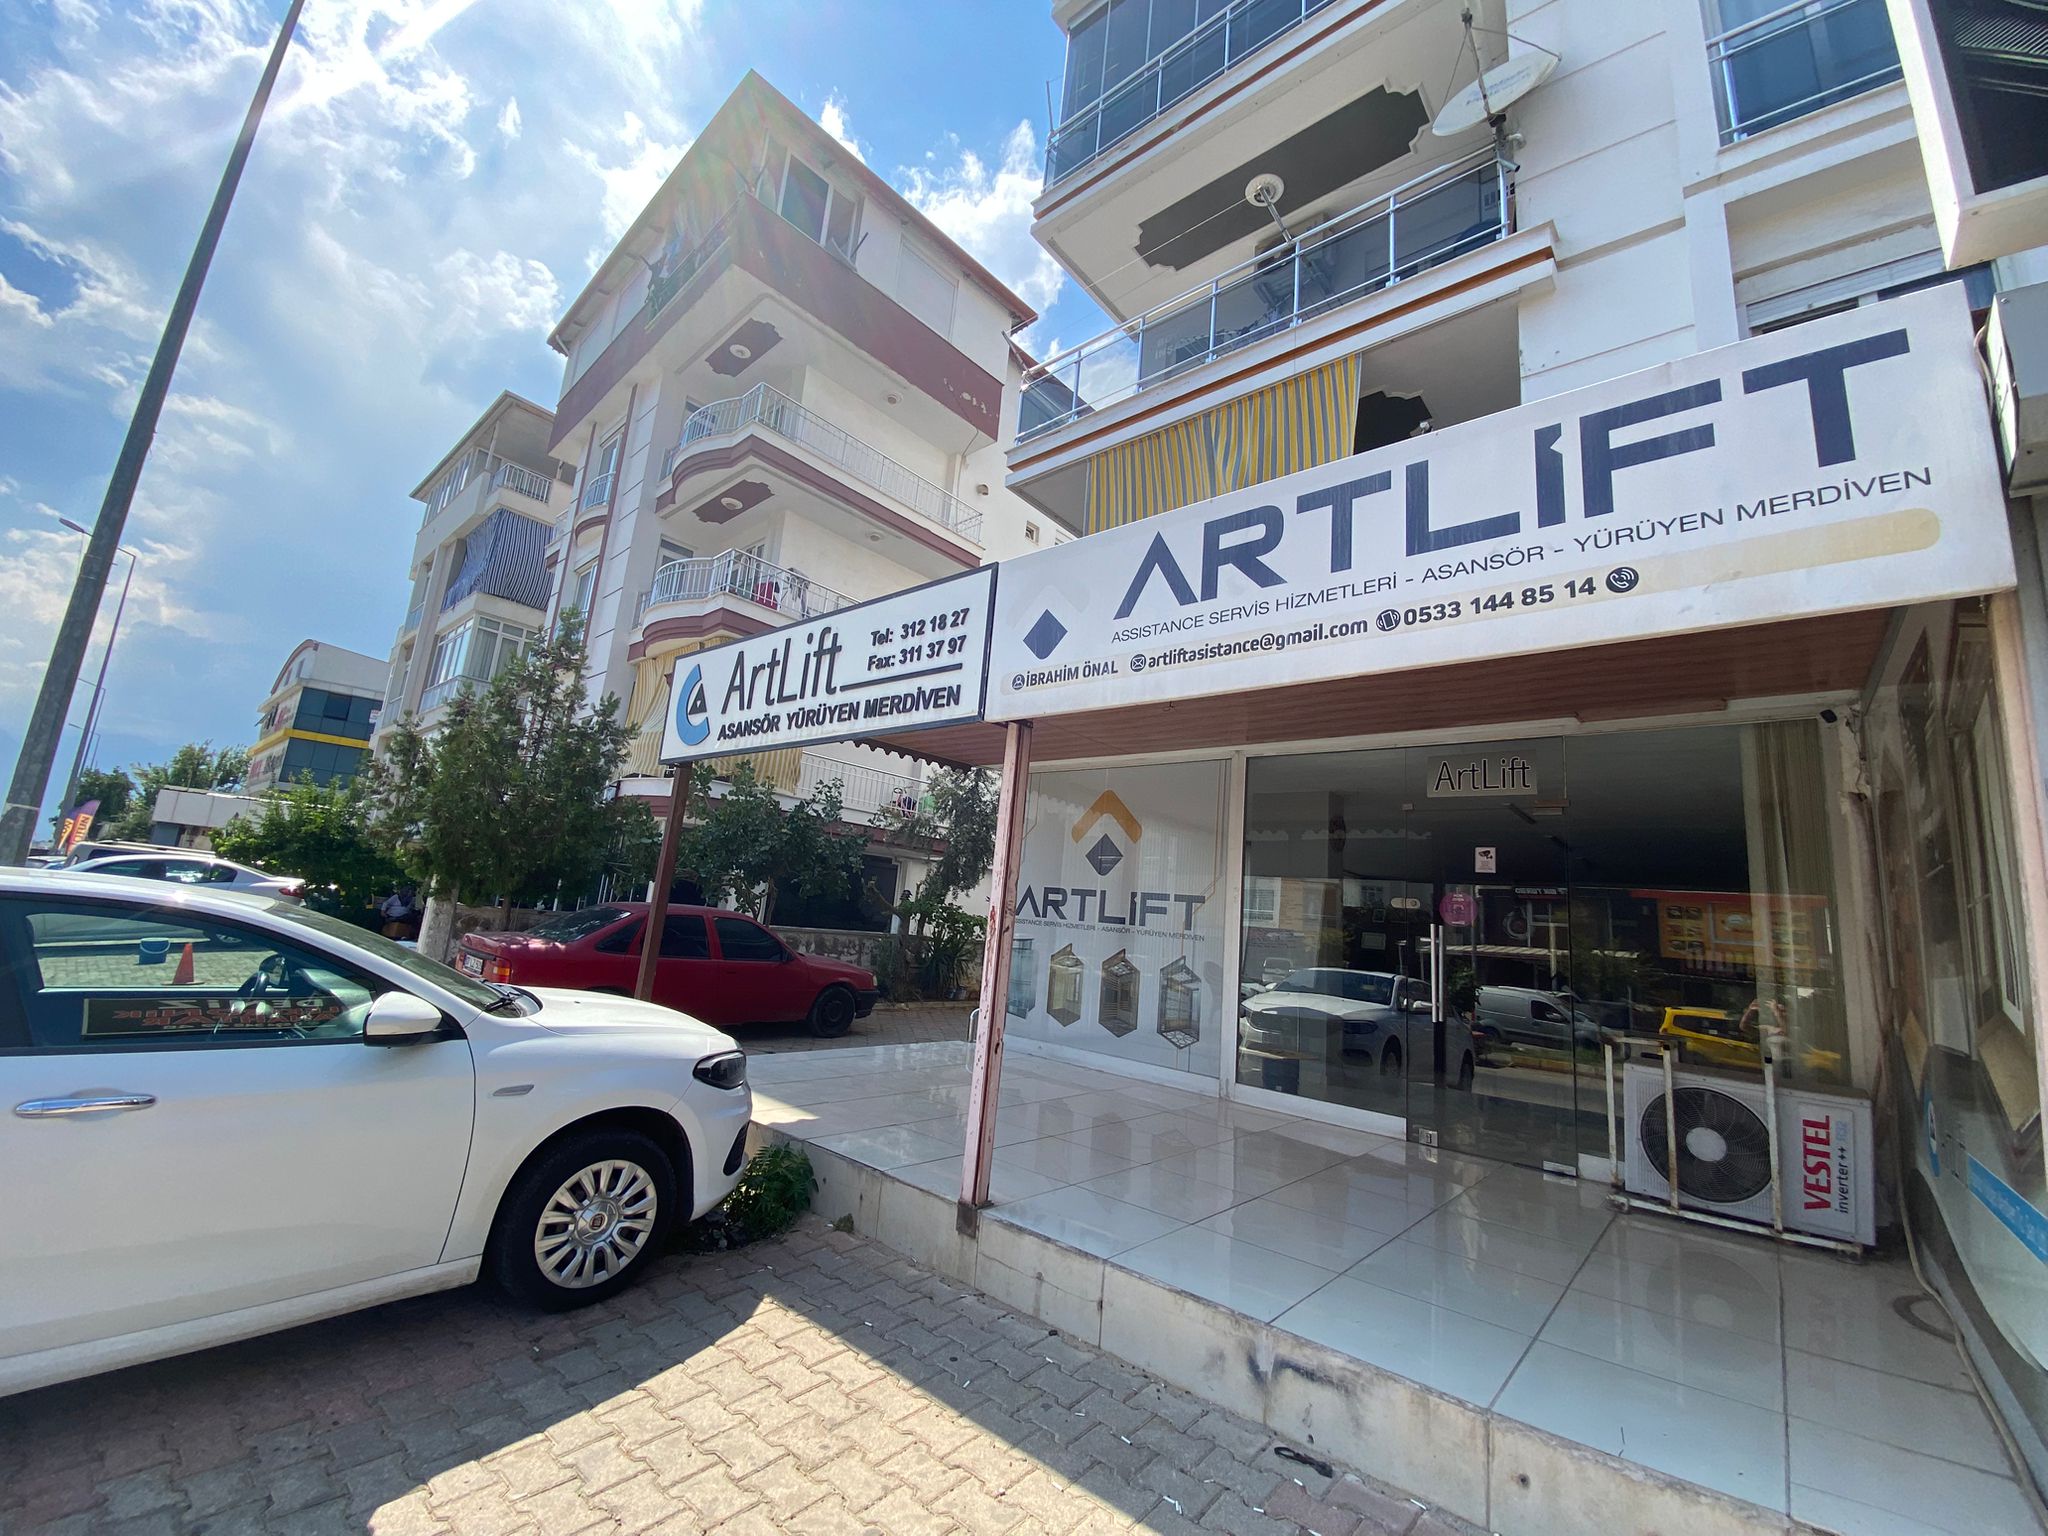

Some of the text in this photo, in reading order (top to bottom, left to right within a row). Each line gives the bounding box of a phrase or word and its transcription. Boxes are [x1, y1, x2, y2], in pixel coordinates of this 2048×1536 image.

[1111, 615, 1205, 644] ASSISTANCE
[1208, 600, 1271, 625] SERVİS
[1275, 571, 1398, 613] HİZMETLERİ
[1421, 544, 1545, 584] ASANSÖR
[1573, 508, 1724, 554] YÜRÜYEN
[1736, 466, 1933, 522] MERDİVEN
[870, 607, 970, 647] Tel: 312 18 27
[1403, 575, 1597, 627] 0533 144 85 14
[867, 634, 967, 672] Fax: 311 37 97
[1147, 616, 1368, 669] artliftasistance@gmail.com
[720, 626, 842, 715] ArtLift
[1025, 660, 1119, 688] İBRAHİM ÖNAL
[717, 684, 961, 741] ASANSÖR YÜRÜYEN MERDİVEN
[1434, 756, 1531, 792] ArtLift
[1802, 1115, 1831, 1210] VESTEL
